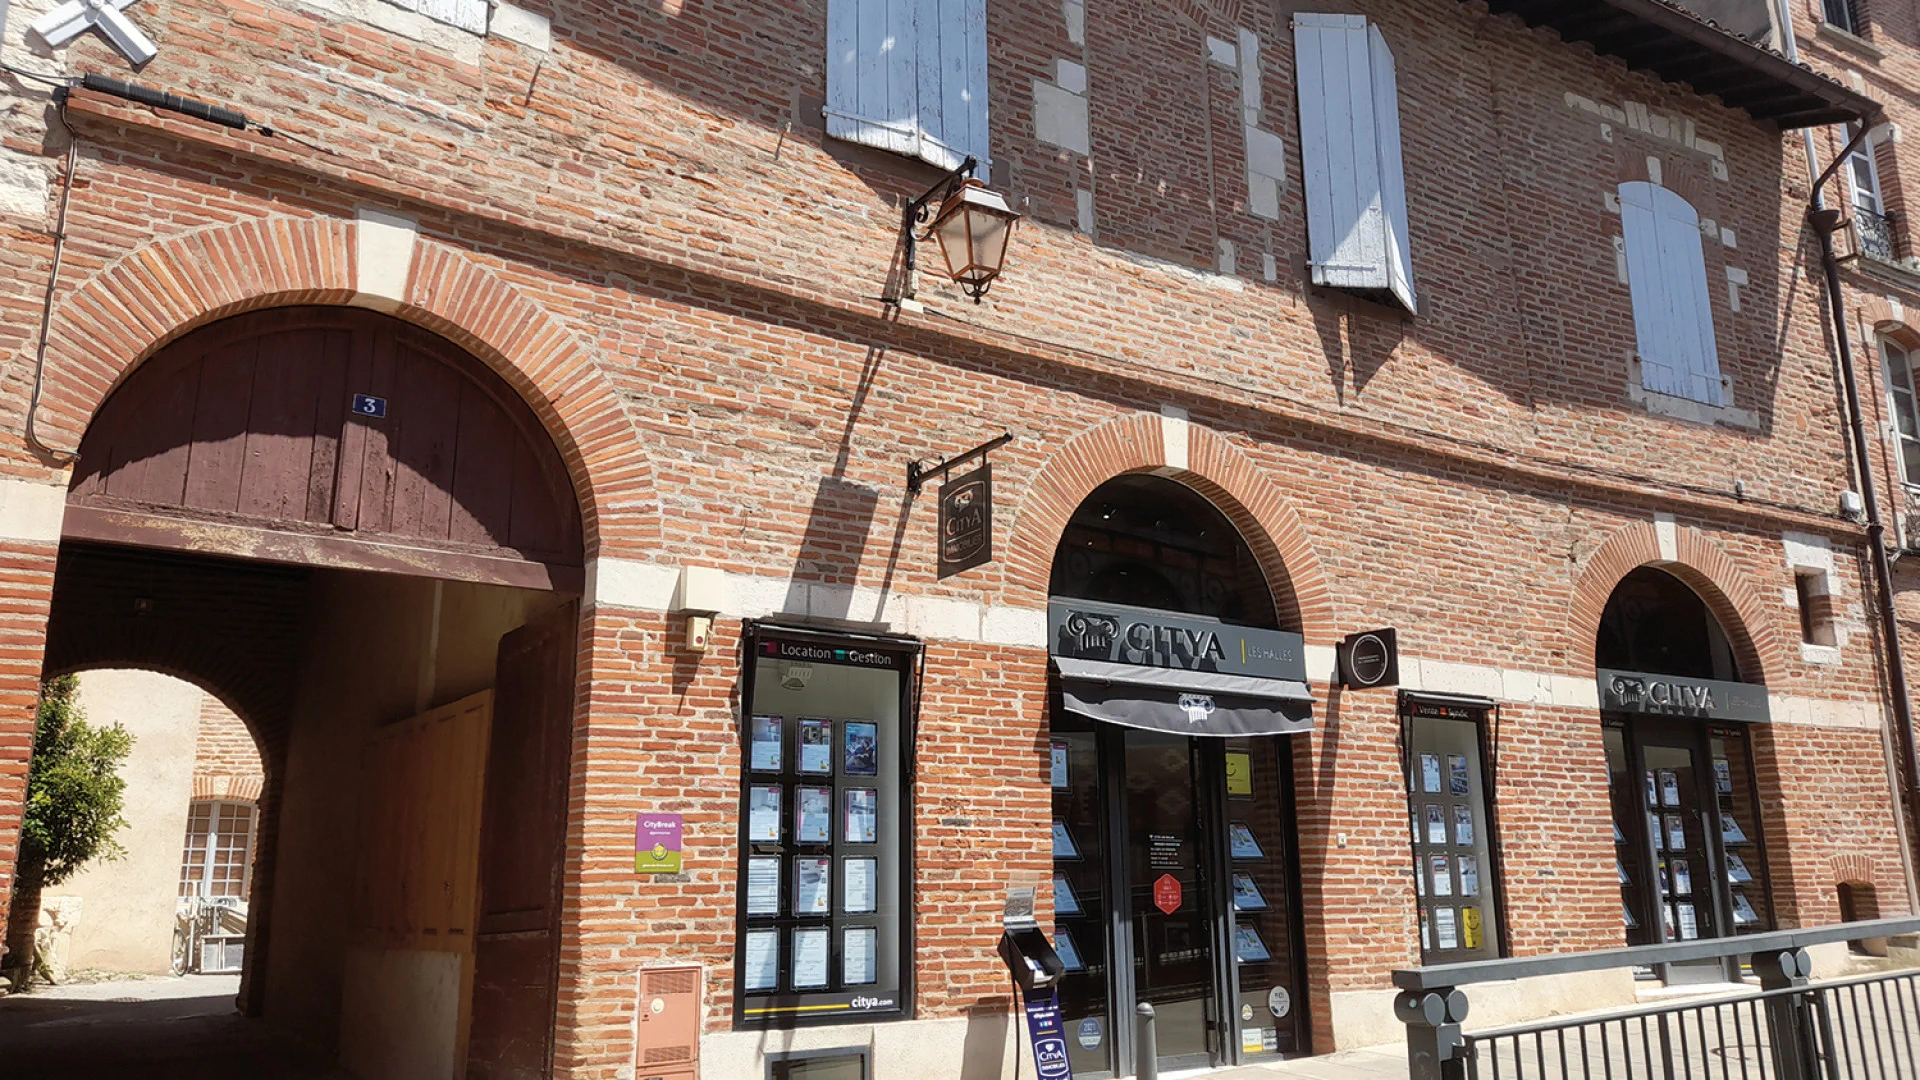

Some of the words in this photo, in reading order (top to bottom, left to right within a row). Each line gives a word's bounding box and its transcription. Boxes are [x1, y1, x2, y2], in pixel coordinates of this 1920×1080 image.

[363, 398, 376, 413] 3
[946, 507, 982, 536] CITYA
[1125, 621, 1226, 661] CITYA
[781, 642, 831, 659] Location
[849, 650, 892, 665] Gestion
[1247, 645, 1262, 659] LES
[1263, 648, 1293, 663] HALLES
[1649, 681, 1717, 710] CITYA
[1418, 704, 1438, 715] Vente
[643, 820, 676, 829] CityBreak
[851, 995, 893, 1009] citya.com
